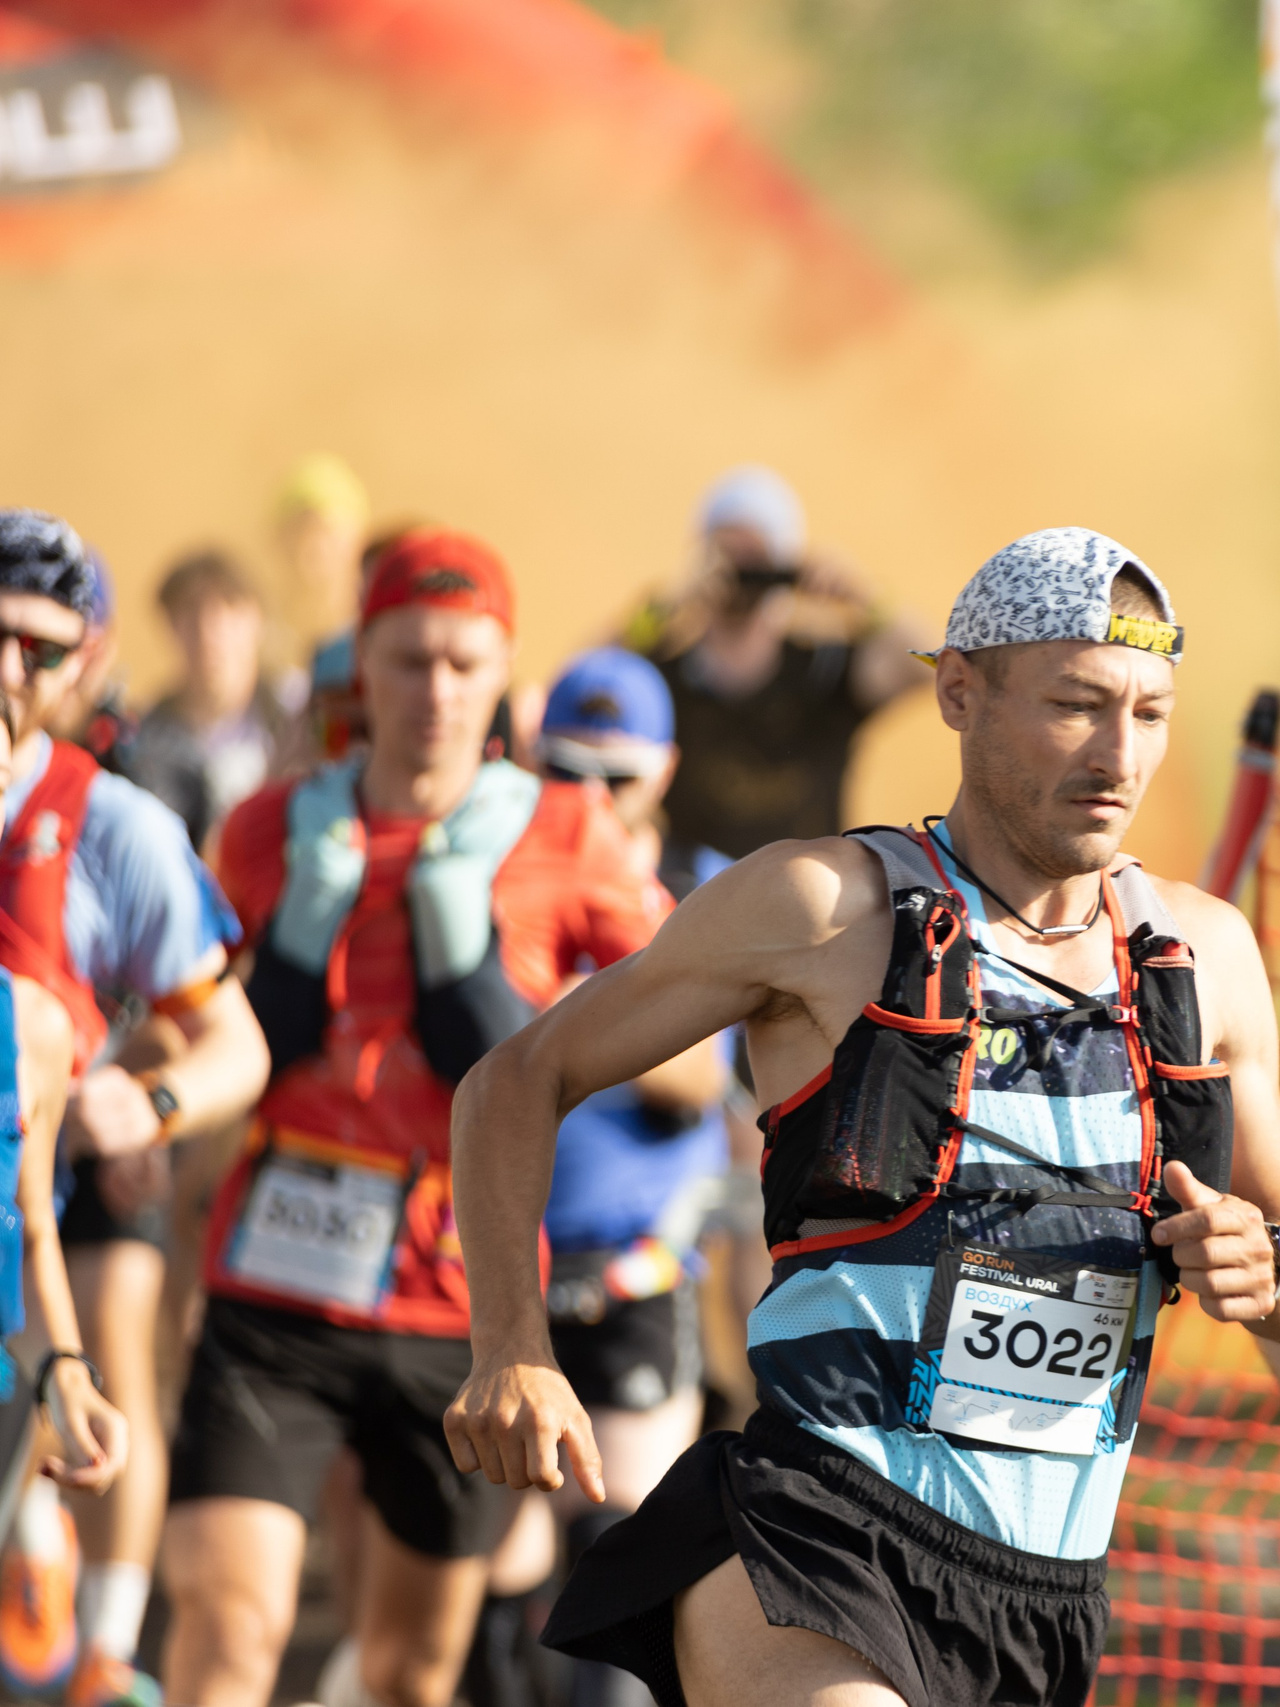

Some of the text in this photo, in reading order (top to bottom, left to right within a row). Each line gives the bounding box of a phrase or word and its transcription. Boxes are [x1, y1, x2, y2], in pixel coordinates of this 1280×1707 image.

[962, 1251, 1015, 1271] GO RUN
[959, 1262, 1061, 1293] FESTIVAL URAL
[964, 1287, 1034, 1313] ВОЗДУХ
[1093, 1312, 1109, 1326] 46
[963, 1309, 1113, 1380] 3022
